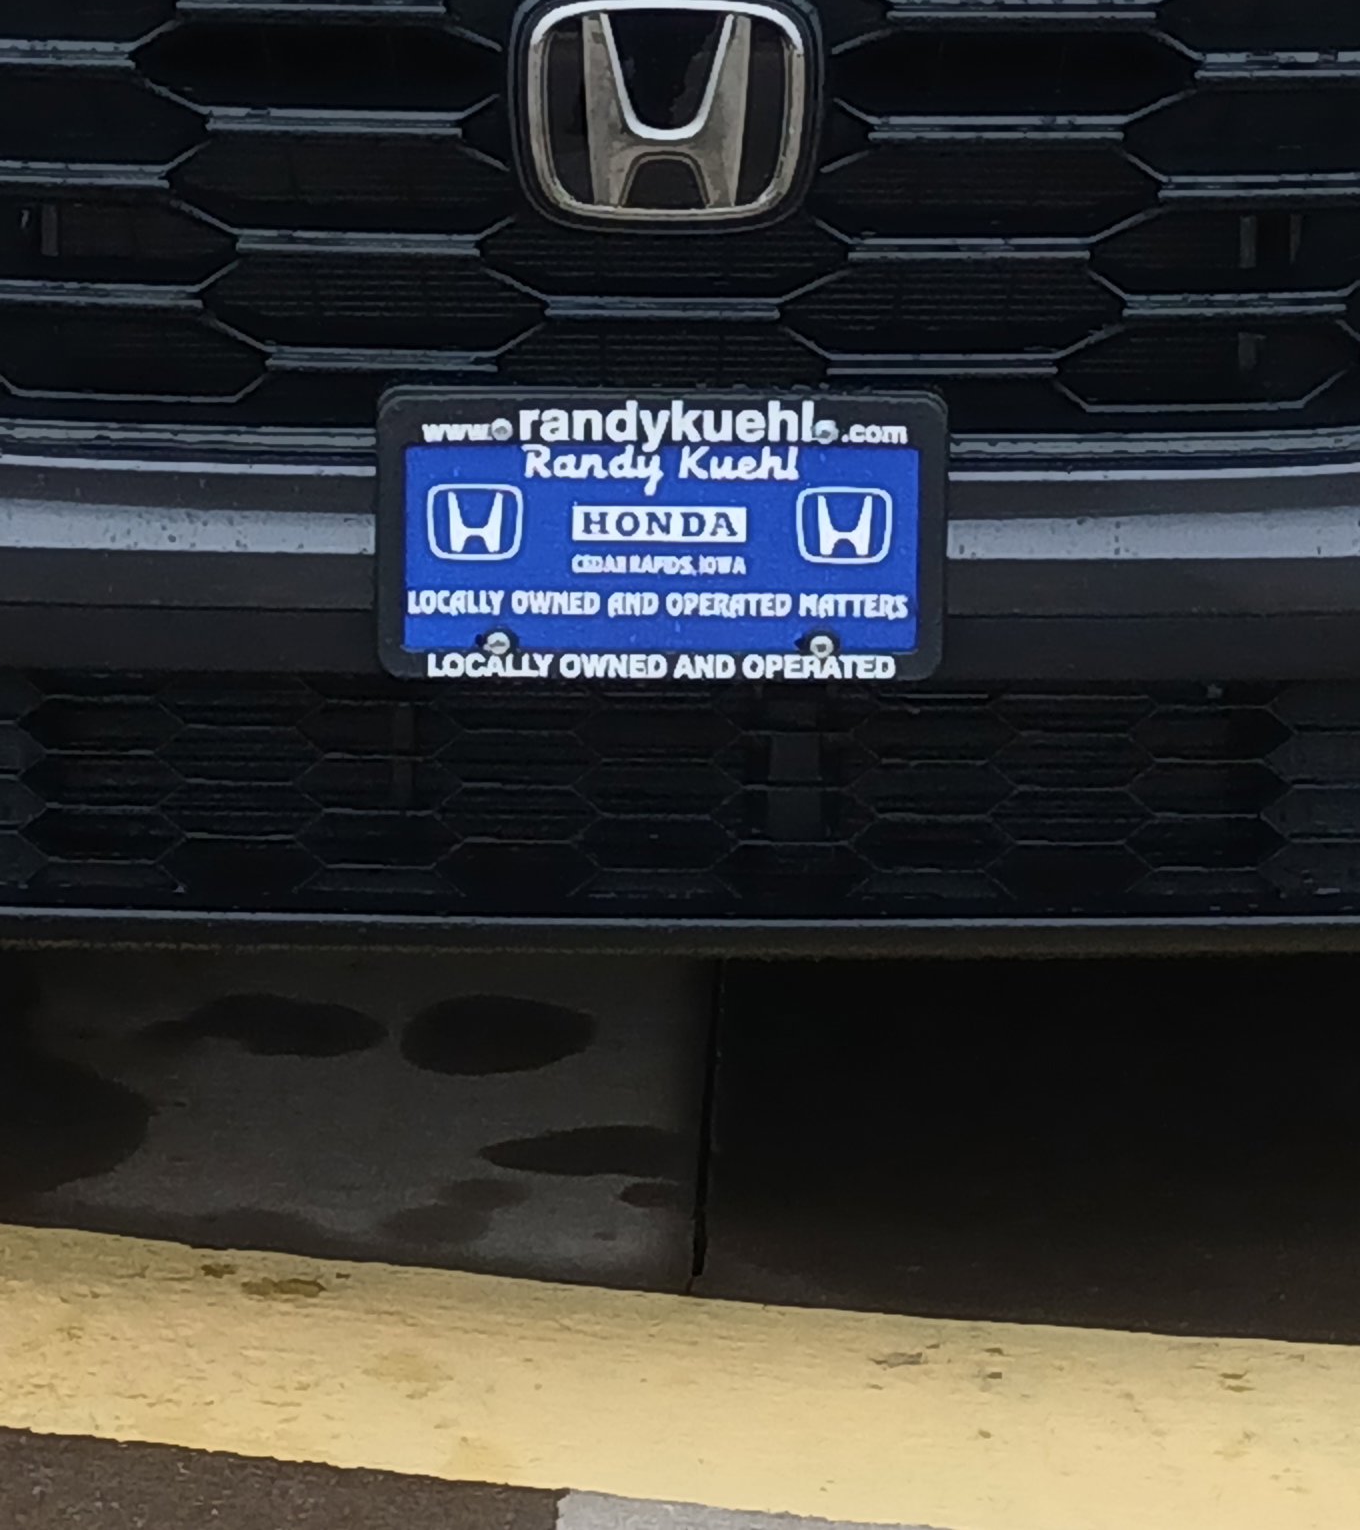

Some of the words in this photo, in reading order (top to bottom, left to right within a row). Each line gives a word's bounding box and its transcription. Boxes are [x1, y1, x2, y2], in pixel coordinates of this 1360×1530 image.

[521, 444, 662, 496] Randy
[678, 446, 800, 480] Kuehl
[582, 510, 738, 537] HONDA
[407, 590, 504, 616] LOCALLY
[511, 591, 601, 615] OWNED
[607, 591, 659, 618] AND
[666, 592, 792, 618] OPERATED
[798, 593, 909, 620] MATTERS
[427, 653, 554, 678] LOCALLY
[559, 653, 668, 679] OWNED
[673, 654, 736, 680] AND
[742, 654, 896, 680] OPERATED
